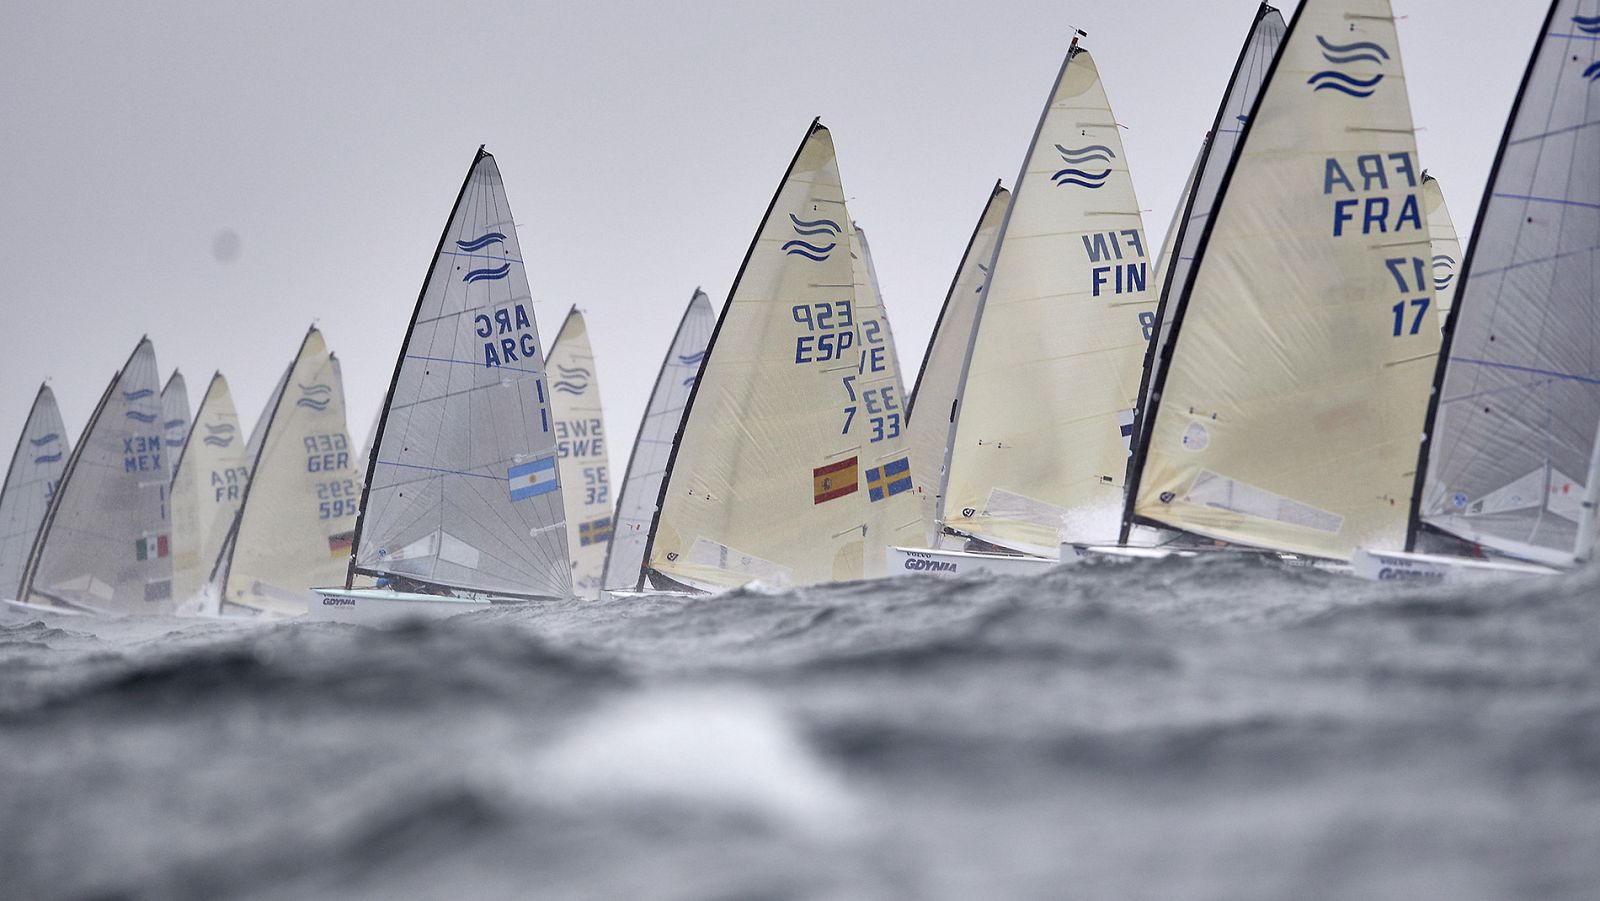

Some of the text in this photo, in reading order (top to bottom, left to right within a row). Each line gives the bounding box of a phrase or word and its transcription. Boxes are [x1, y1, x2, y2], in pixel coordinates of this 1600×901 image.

[1333, 194, 1422, 236] FRA
[1092, 262, 1146, 297] FIN
[1392, 297, 1431, 337] 17
[484, 333, 536, 368] ARG
[795, 331, 853, 364] ESP
[841, 406, 857, 435] 7
[869, 413, 900, 443] 33
[557, 438, 603, 459] SWE
[124, 454, 162, 474] MEX
[308, 452, 348, 473] GER
[215, 484, 240, 503] FR
[584, 485, 608, 505] 32
[319, 498, 357, 520] 595
[904, 558, 958, 573] GDYNIA
[906, 551, 932, 559] VOLVO
[322, 597, 356, 606] GDYNIA
